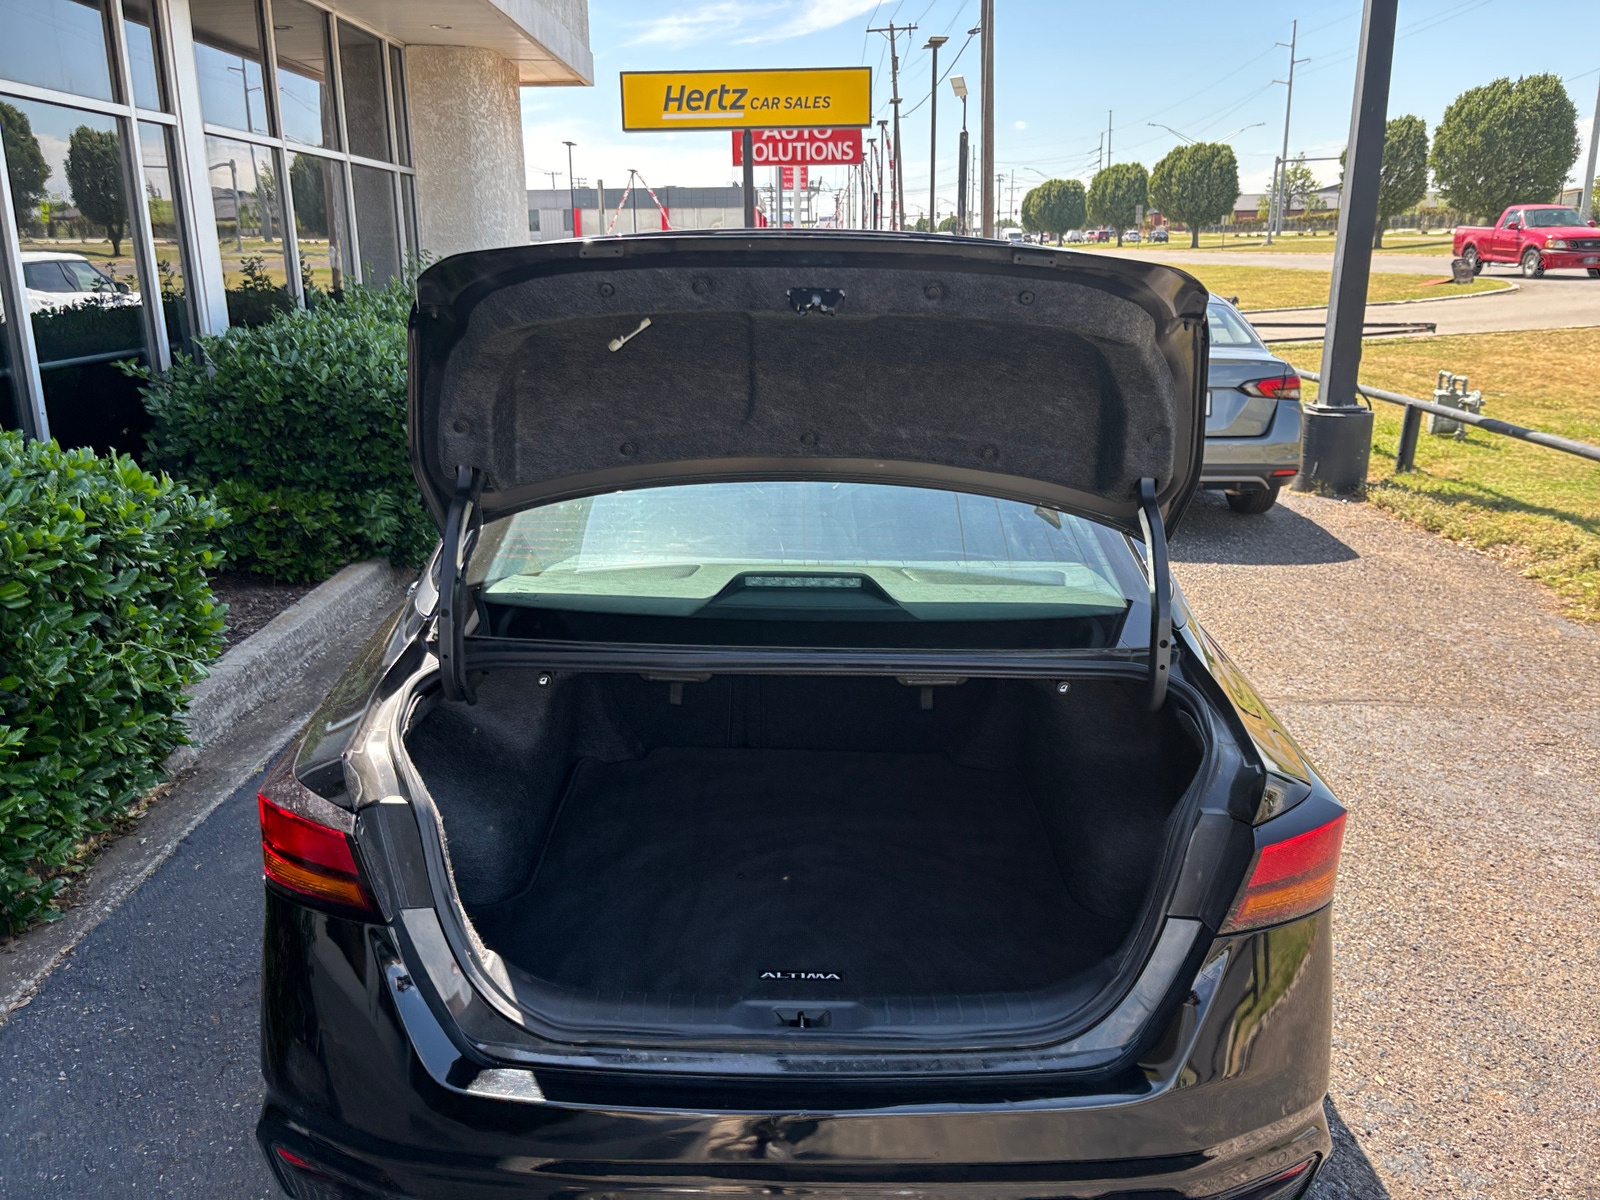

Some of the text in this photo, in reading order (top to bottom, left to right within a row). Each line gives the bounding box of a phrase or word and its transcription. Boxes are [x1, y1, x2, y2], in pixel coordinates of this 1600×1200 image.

[663, 84, 831, 111] Hertz CAR SALES
[740, 141, 854, 162] OLUTIONS
[760, 971, 841, 980] ALTIMA
